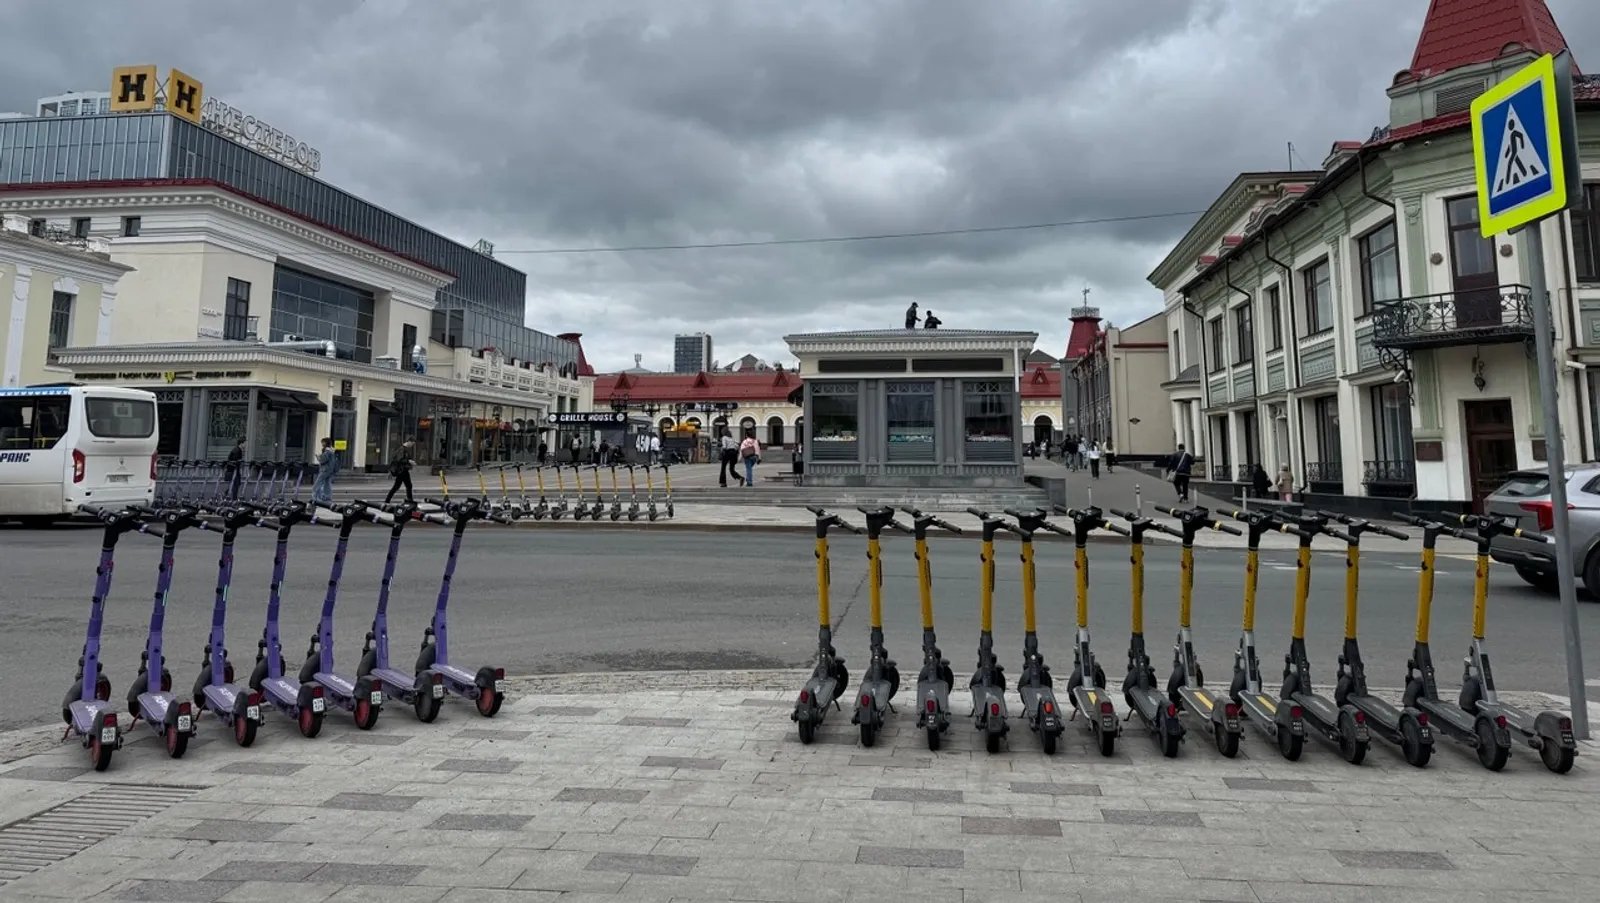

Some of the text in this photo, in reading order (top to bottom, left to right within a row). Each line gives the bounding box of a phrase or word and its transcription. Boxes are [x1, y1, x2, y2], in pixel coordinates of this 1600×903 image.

[205, 96, 322, 173] НЕСТЕРОВ
[560, 413, 614, 423] GRILLE HOUSE
